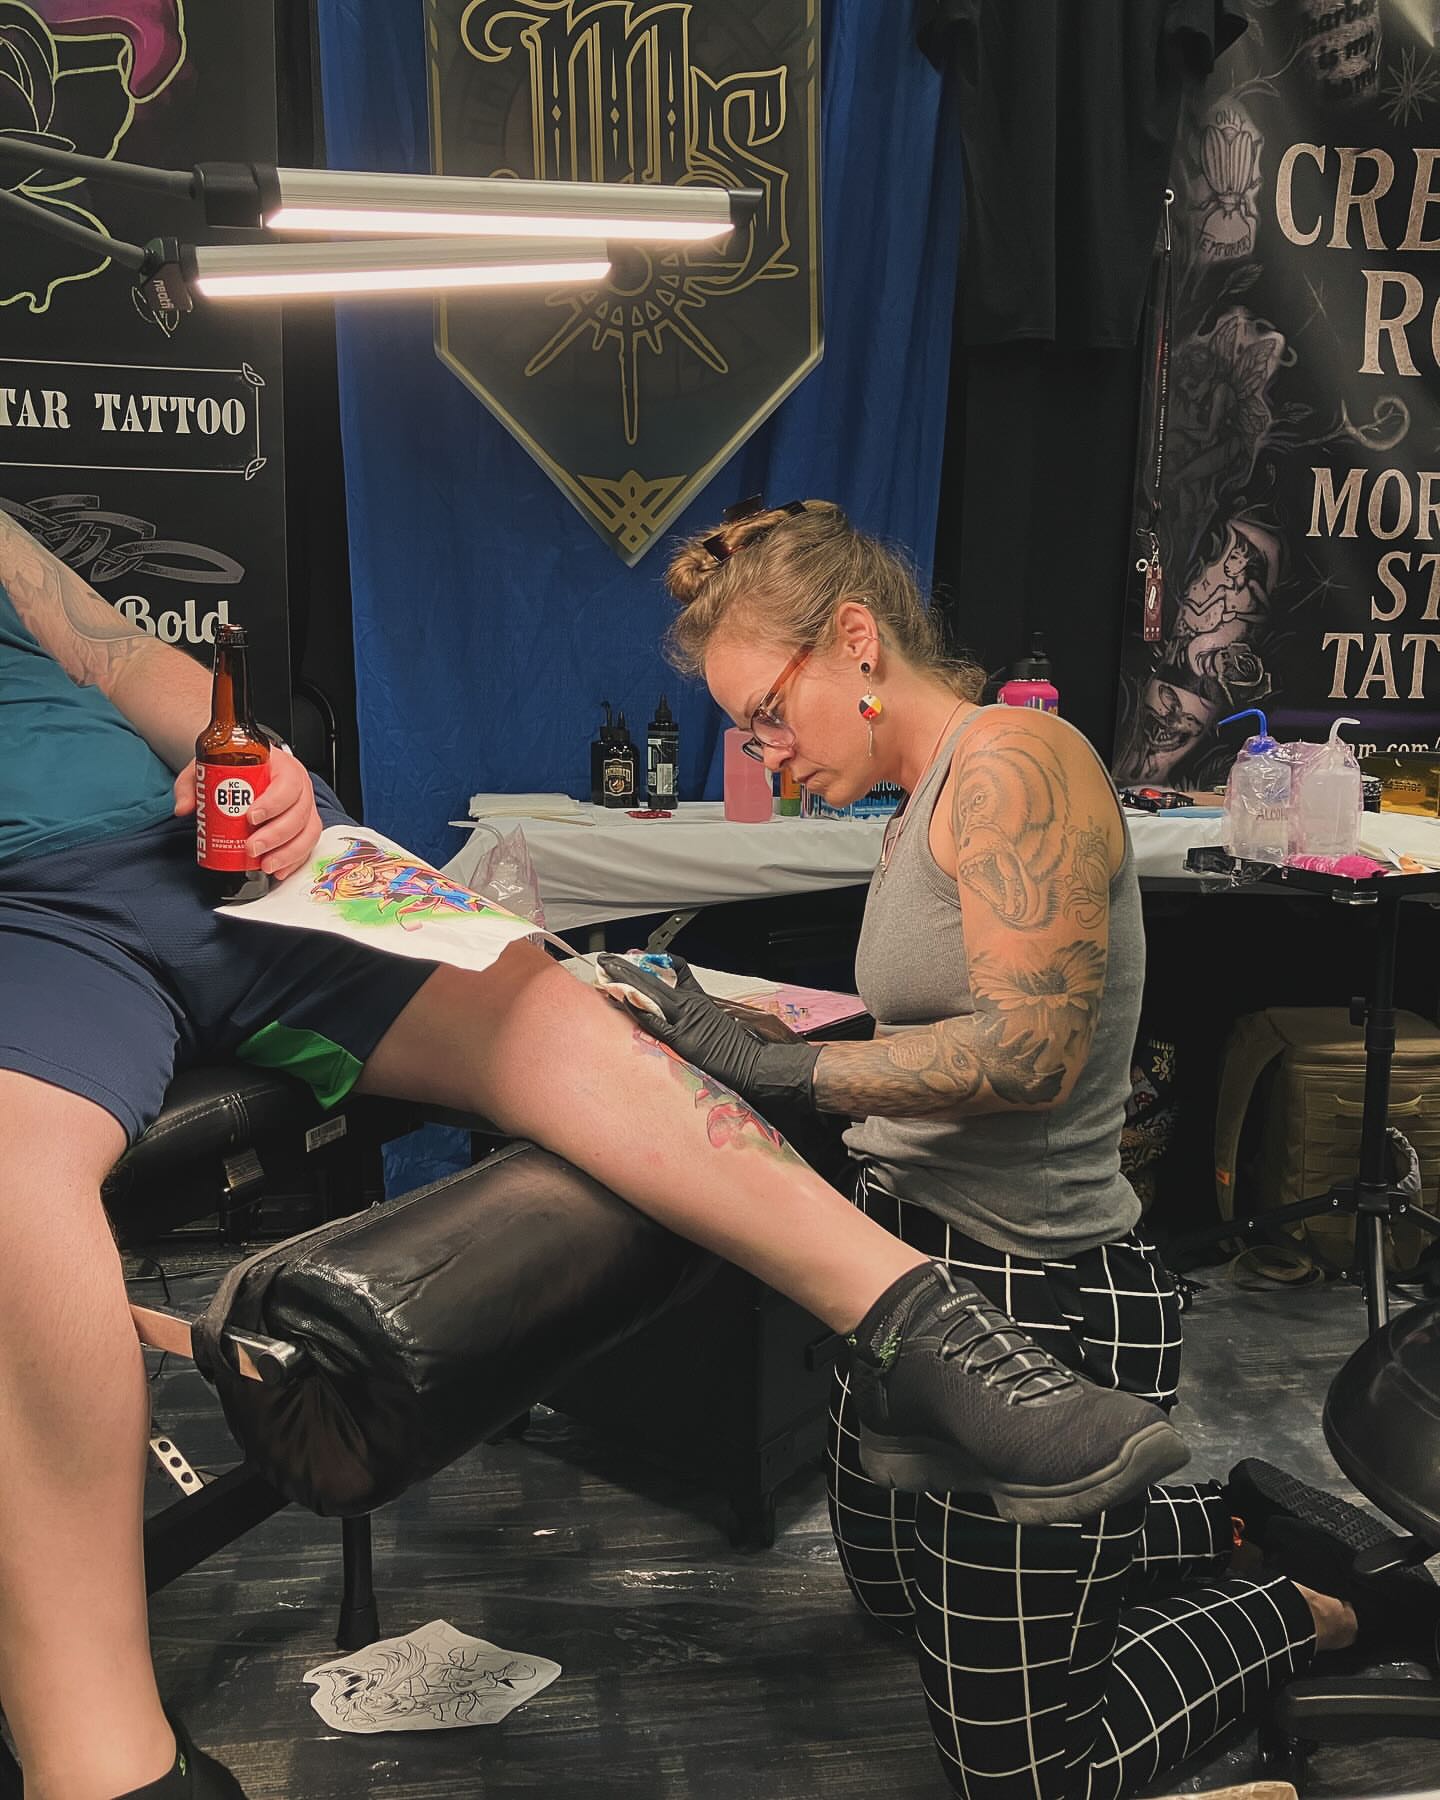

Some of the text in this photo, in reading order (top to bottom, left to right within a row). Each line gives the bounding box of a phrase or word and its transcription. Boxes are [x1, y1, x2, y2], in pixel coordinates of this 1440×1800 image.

[1358, 269, 1440, 376] R
[94, 393, 246, 435] TATTOO
[114, 595, 229, 644] Bold
[228, 781, 240, 789] KC
[196, 763, 206, 863] DUNKEL
[228, 806, 240, 814] CO
